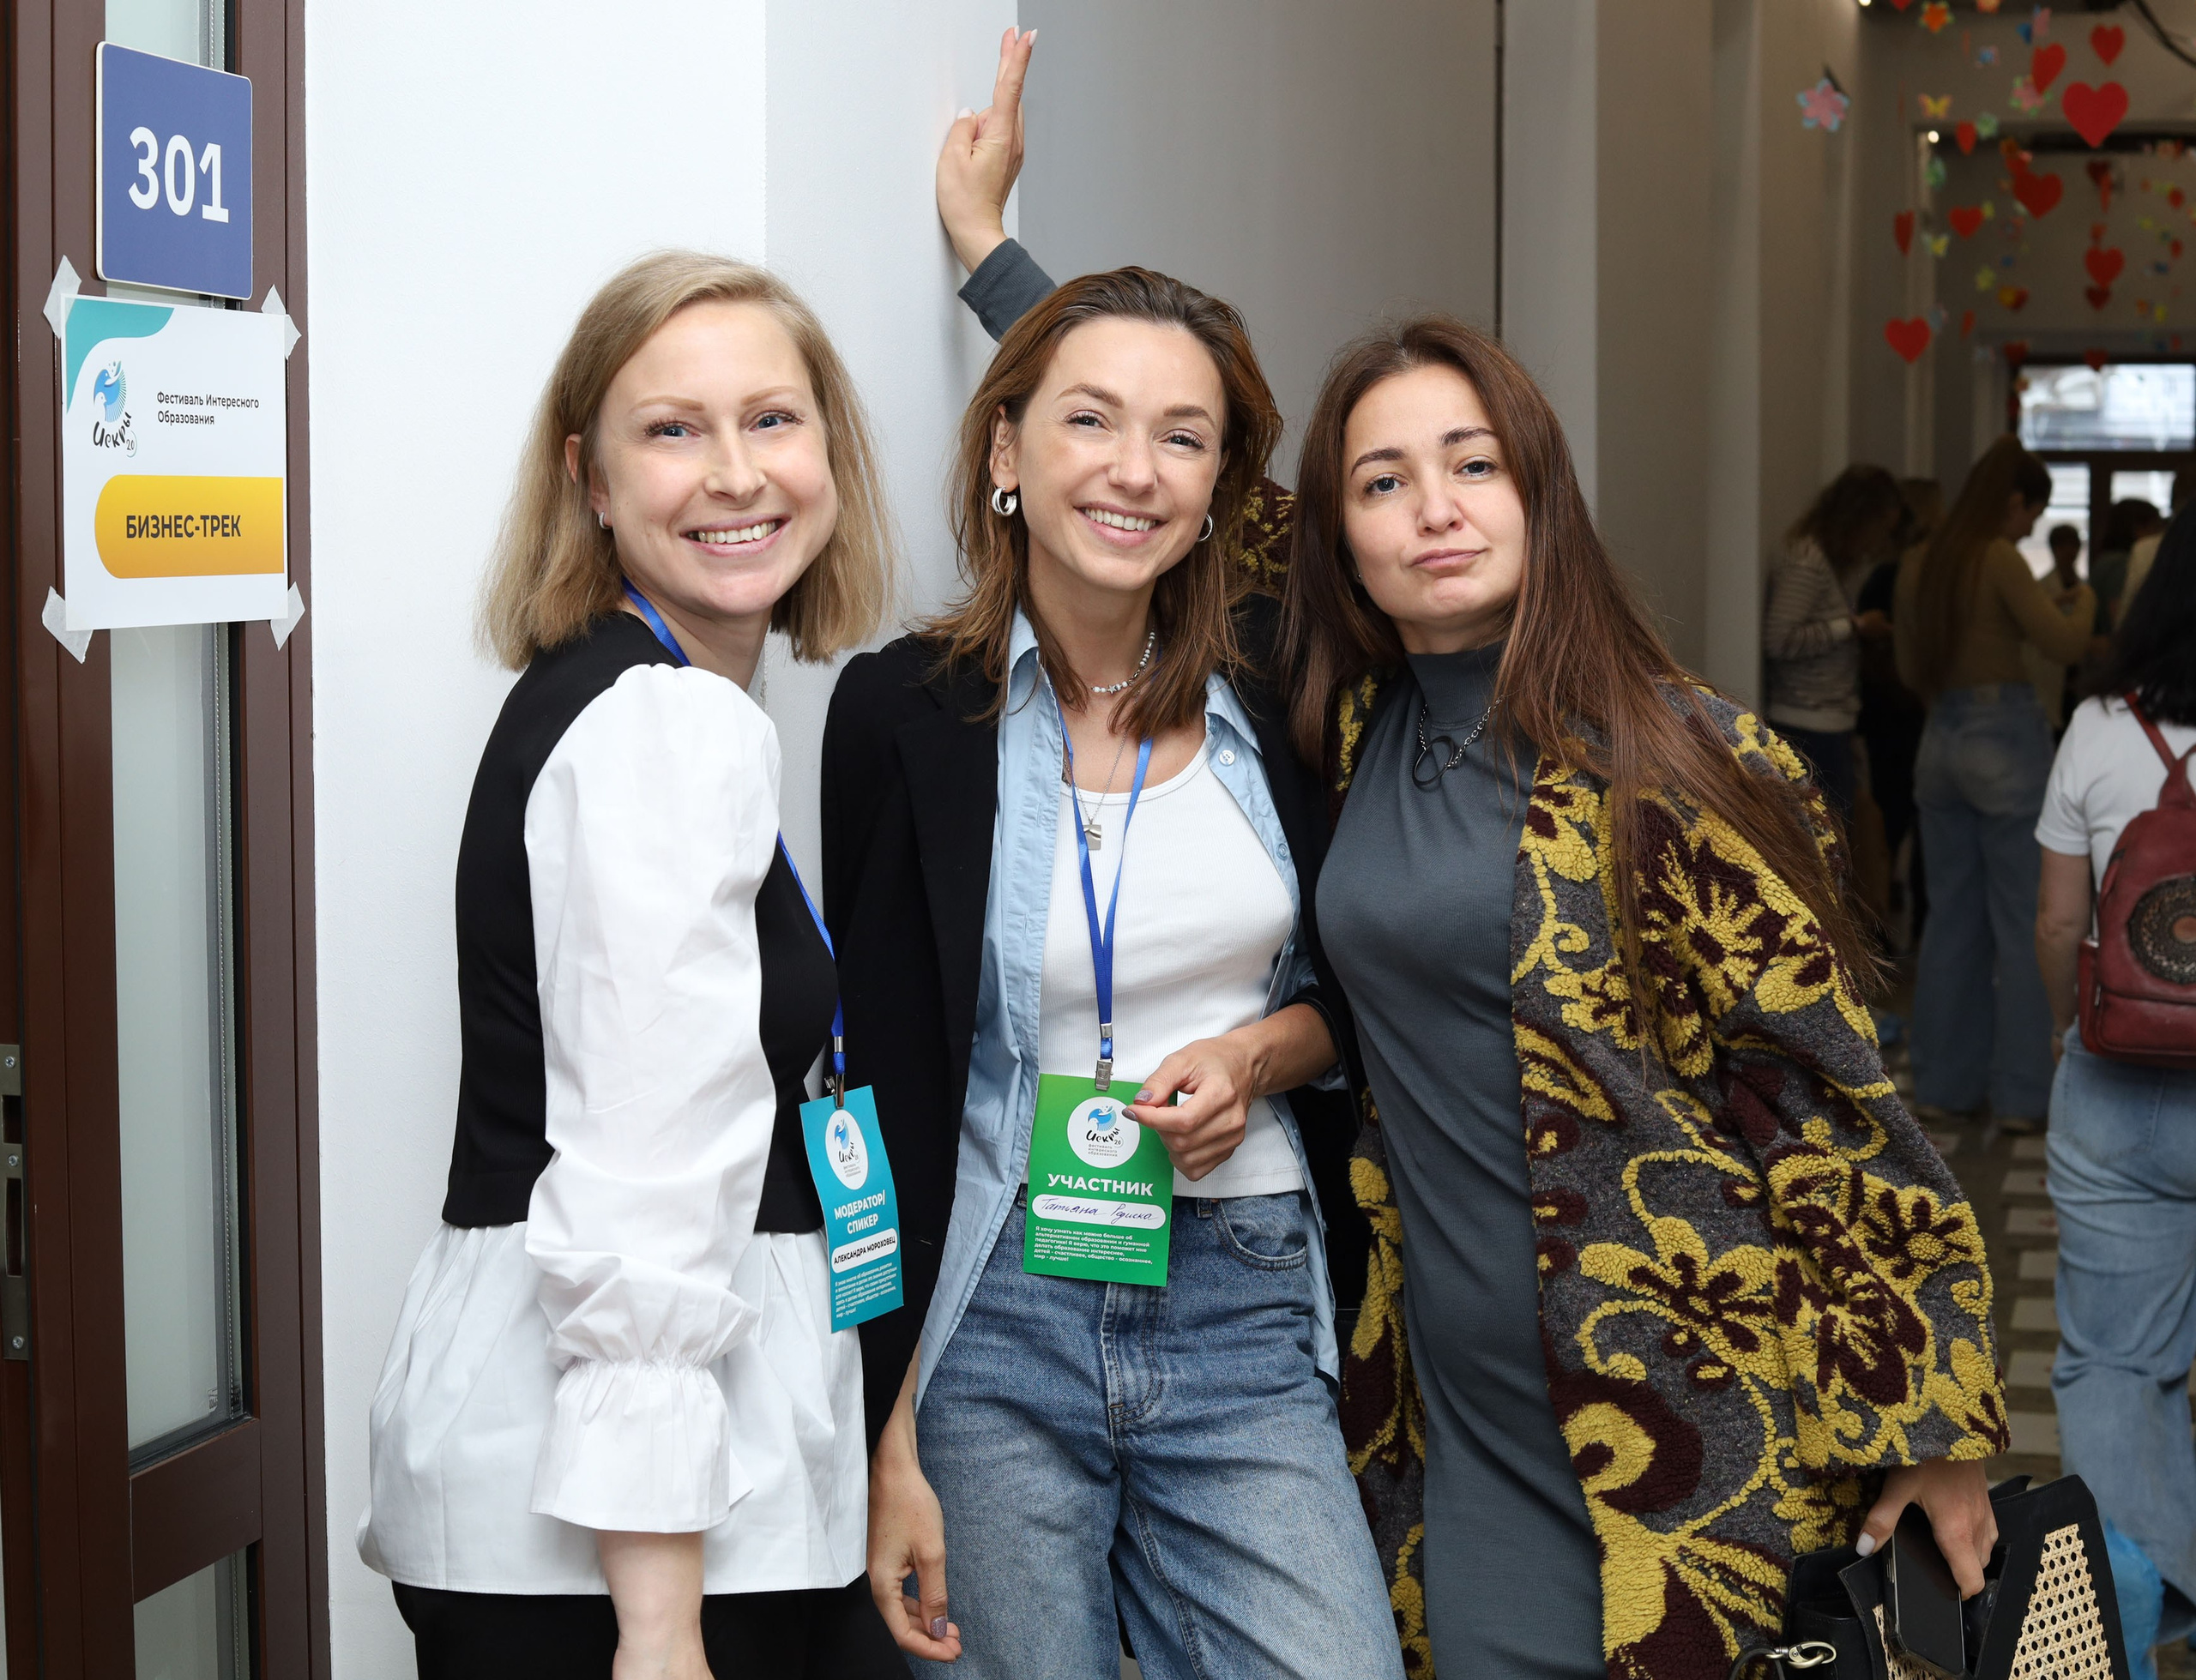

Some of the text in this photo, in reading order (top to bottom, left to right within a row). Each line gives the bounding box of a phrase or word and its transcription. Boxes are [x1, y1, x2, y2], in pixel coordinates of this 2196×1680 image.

[128, 126, 229, 223] 301
[157, 391, 259, 409] Фестиваль Интересного
[157, 410, 214, 425] Образования
[126, 515, 241, 539] БИЗНЕС-ТРЕК
[1047, 1173, 1154, 1196] УЧАСТНИК
[834, 1189, 885, 1219] МОДЕРАТОР/
[1041, 1197, 1101, 1216] Татьяна
[847, 1213, 878, 1234] СПИКЕР
[834, 1236, 896, 1264] АЛЕКСАНДРА МОРОХОВЕЦ
